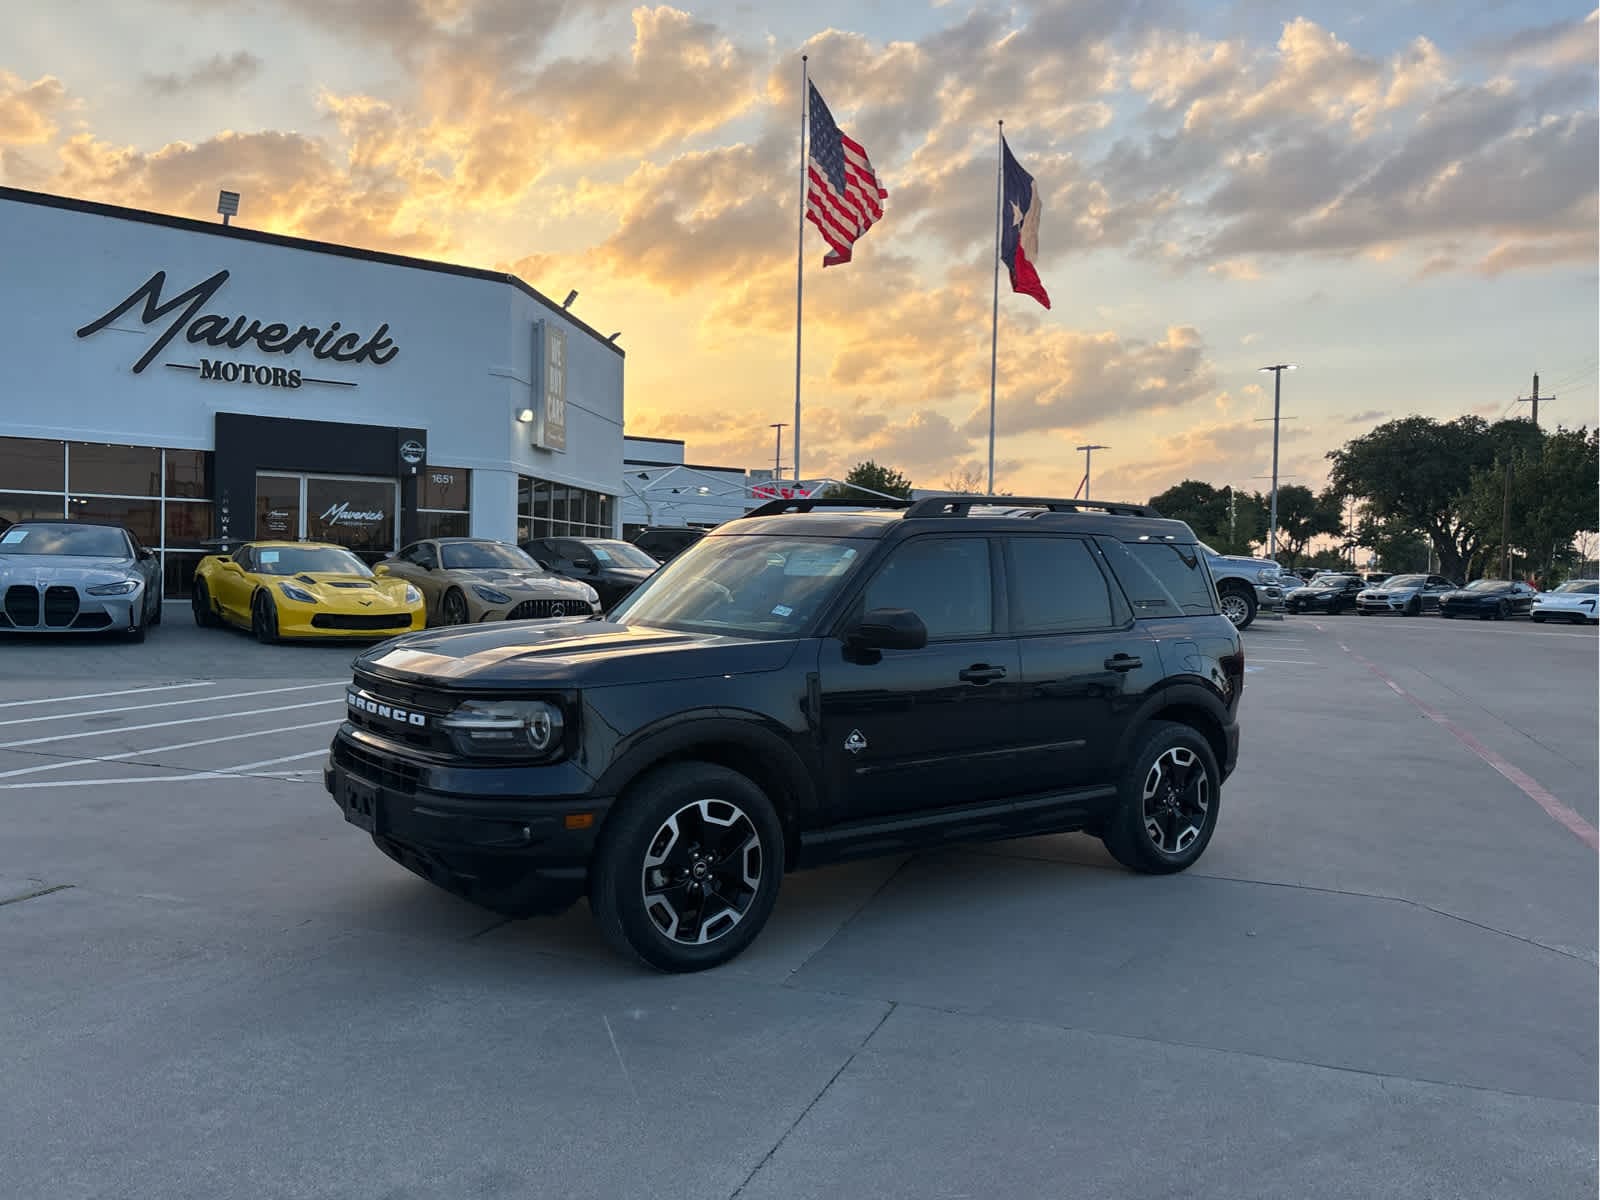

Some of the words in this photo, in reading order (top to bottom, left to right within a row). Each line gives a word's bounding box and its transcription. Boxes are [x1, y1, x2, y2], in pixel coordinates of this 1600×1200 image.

[76, 269, 400, 374] Maverick
[199, 358, 303, 388] MOTORS
[547, 396, 565, 427] CARS
[431, 474, 454, 485] 1651
[319, 501, 384, 526] Maverick
[348, 693, 426, 727] BRONCO
